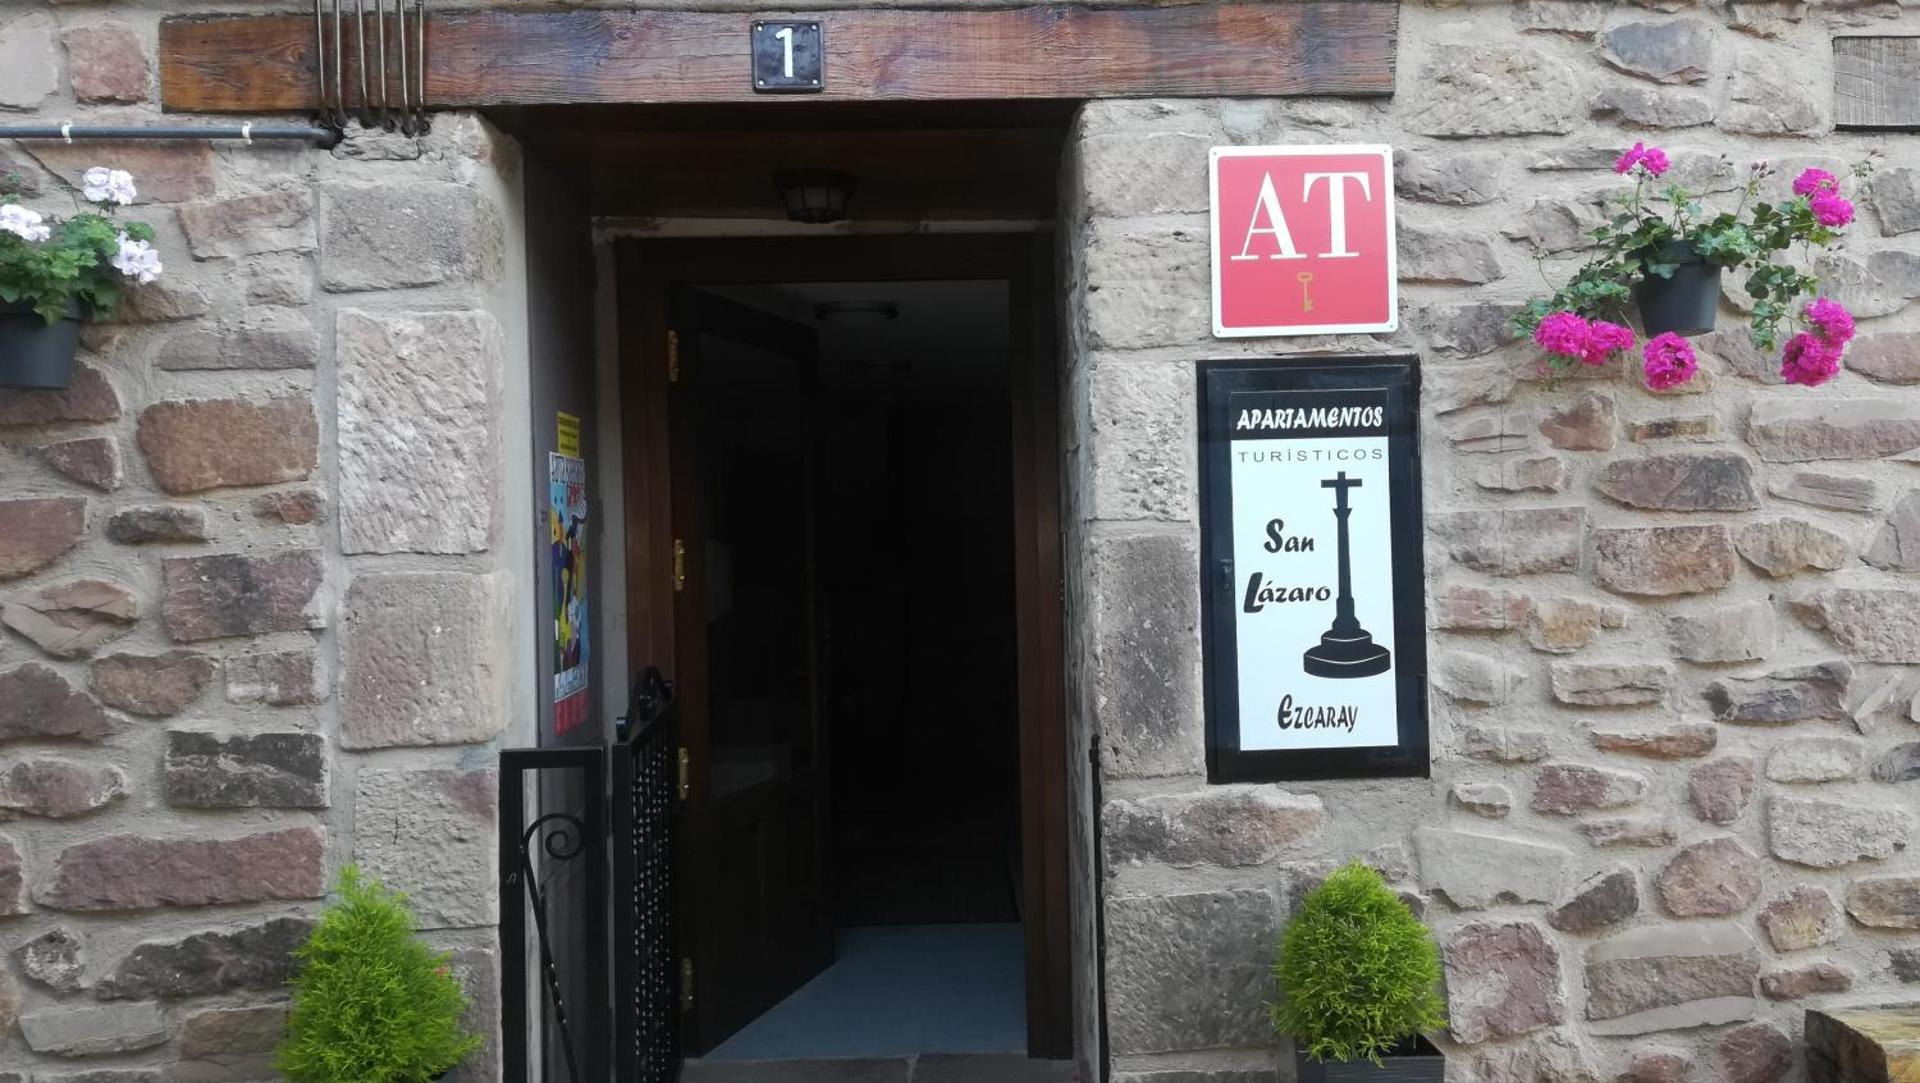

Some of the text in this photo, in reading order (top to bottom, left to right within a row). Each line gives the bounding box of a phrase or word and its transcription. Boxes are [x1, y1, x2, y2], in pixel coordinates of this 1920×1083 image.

[775, 27, 794, 78] 1
[1231, 171, 1371, 261] AT
[1236, 406, 1383, 430] APARTAMENTOS
[1238, 448, 1383, 463] TURÍSTICOS
[1263, 518, 1315, 553] San
[1243, 571, 1331, 614] Lázaro
